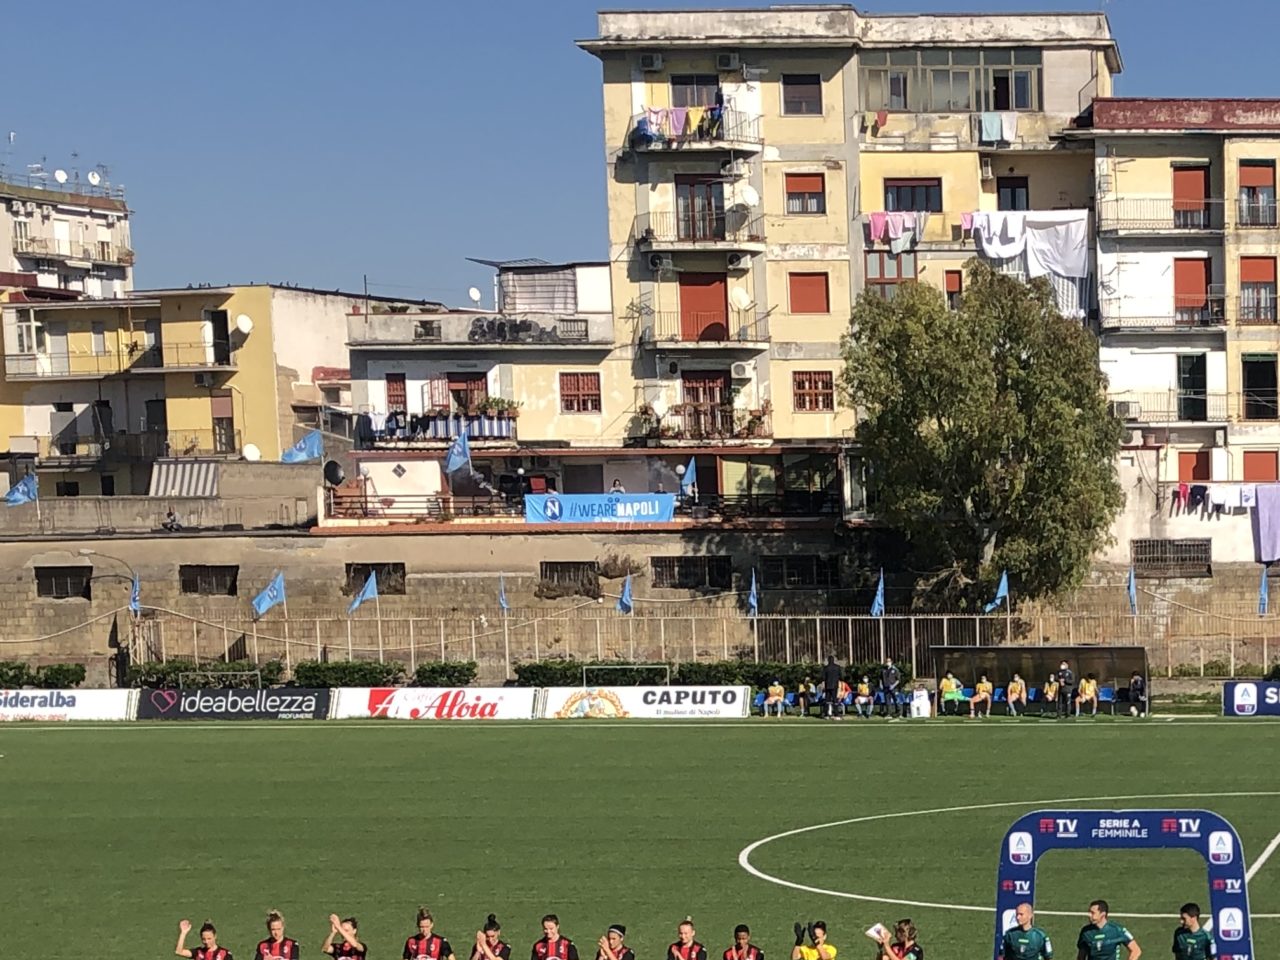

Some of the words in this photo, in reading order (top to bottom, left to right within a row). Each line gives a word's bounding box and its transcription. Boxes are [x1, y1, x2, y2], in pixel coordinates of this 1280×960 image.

[179, 689, 316, 713] ideabellezza
[409, 689, 499, 719] Aloia
[642, 689, 738, 706] CAPUTO
[1056, 819, 1078, 833] TV
[1099, 818, 1131, 828] SERIE
[1132, 818, 1141, 828] A
[1178, 818, 1201, 833] TV
[1091, 828, 1149, 839] FEMMINILE
[1014, 880, 1031, 891] TV
[1225, 878, 1242, 890] TV
